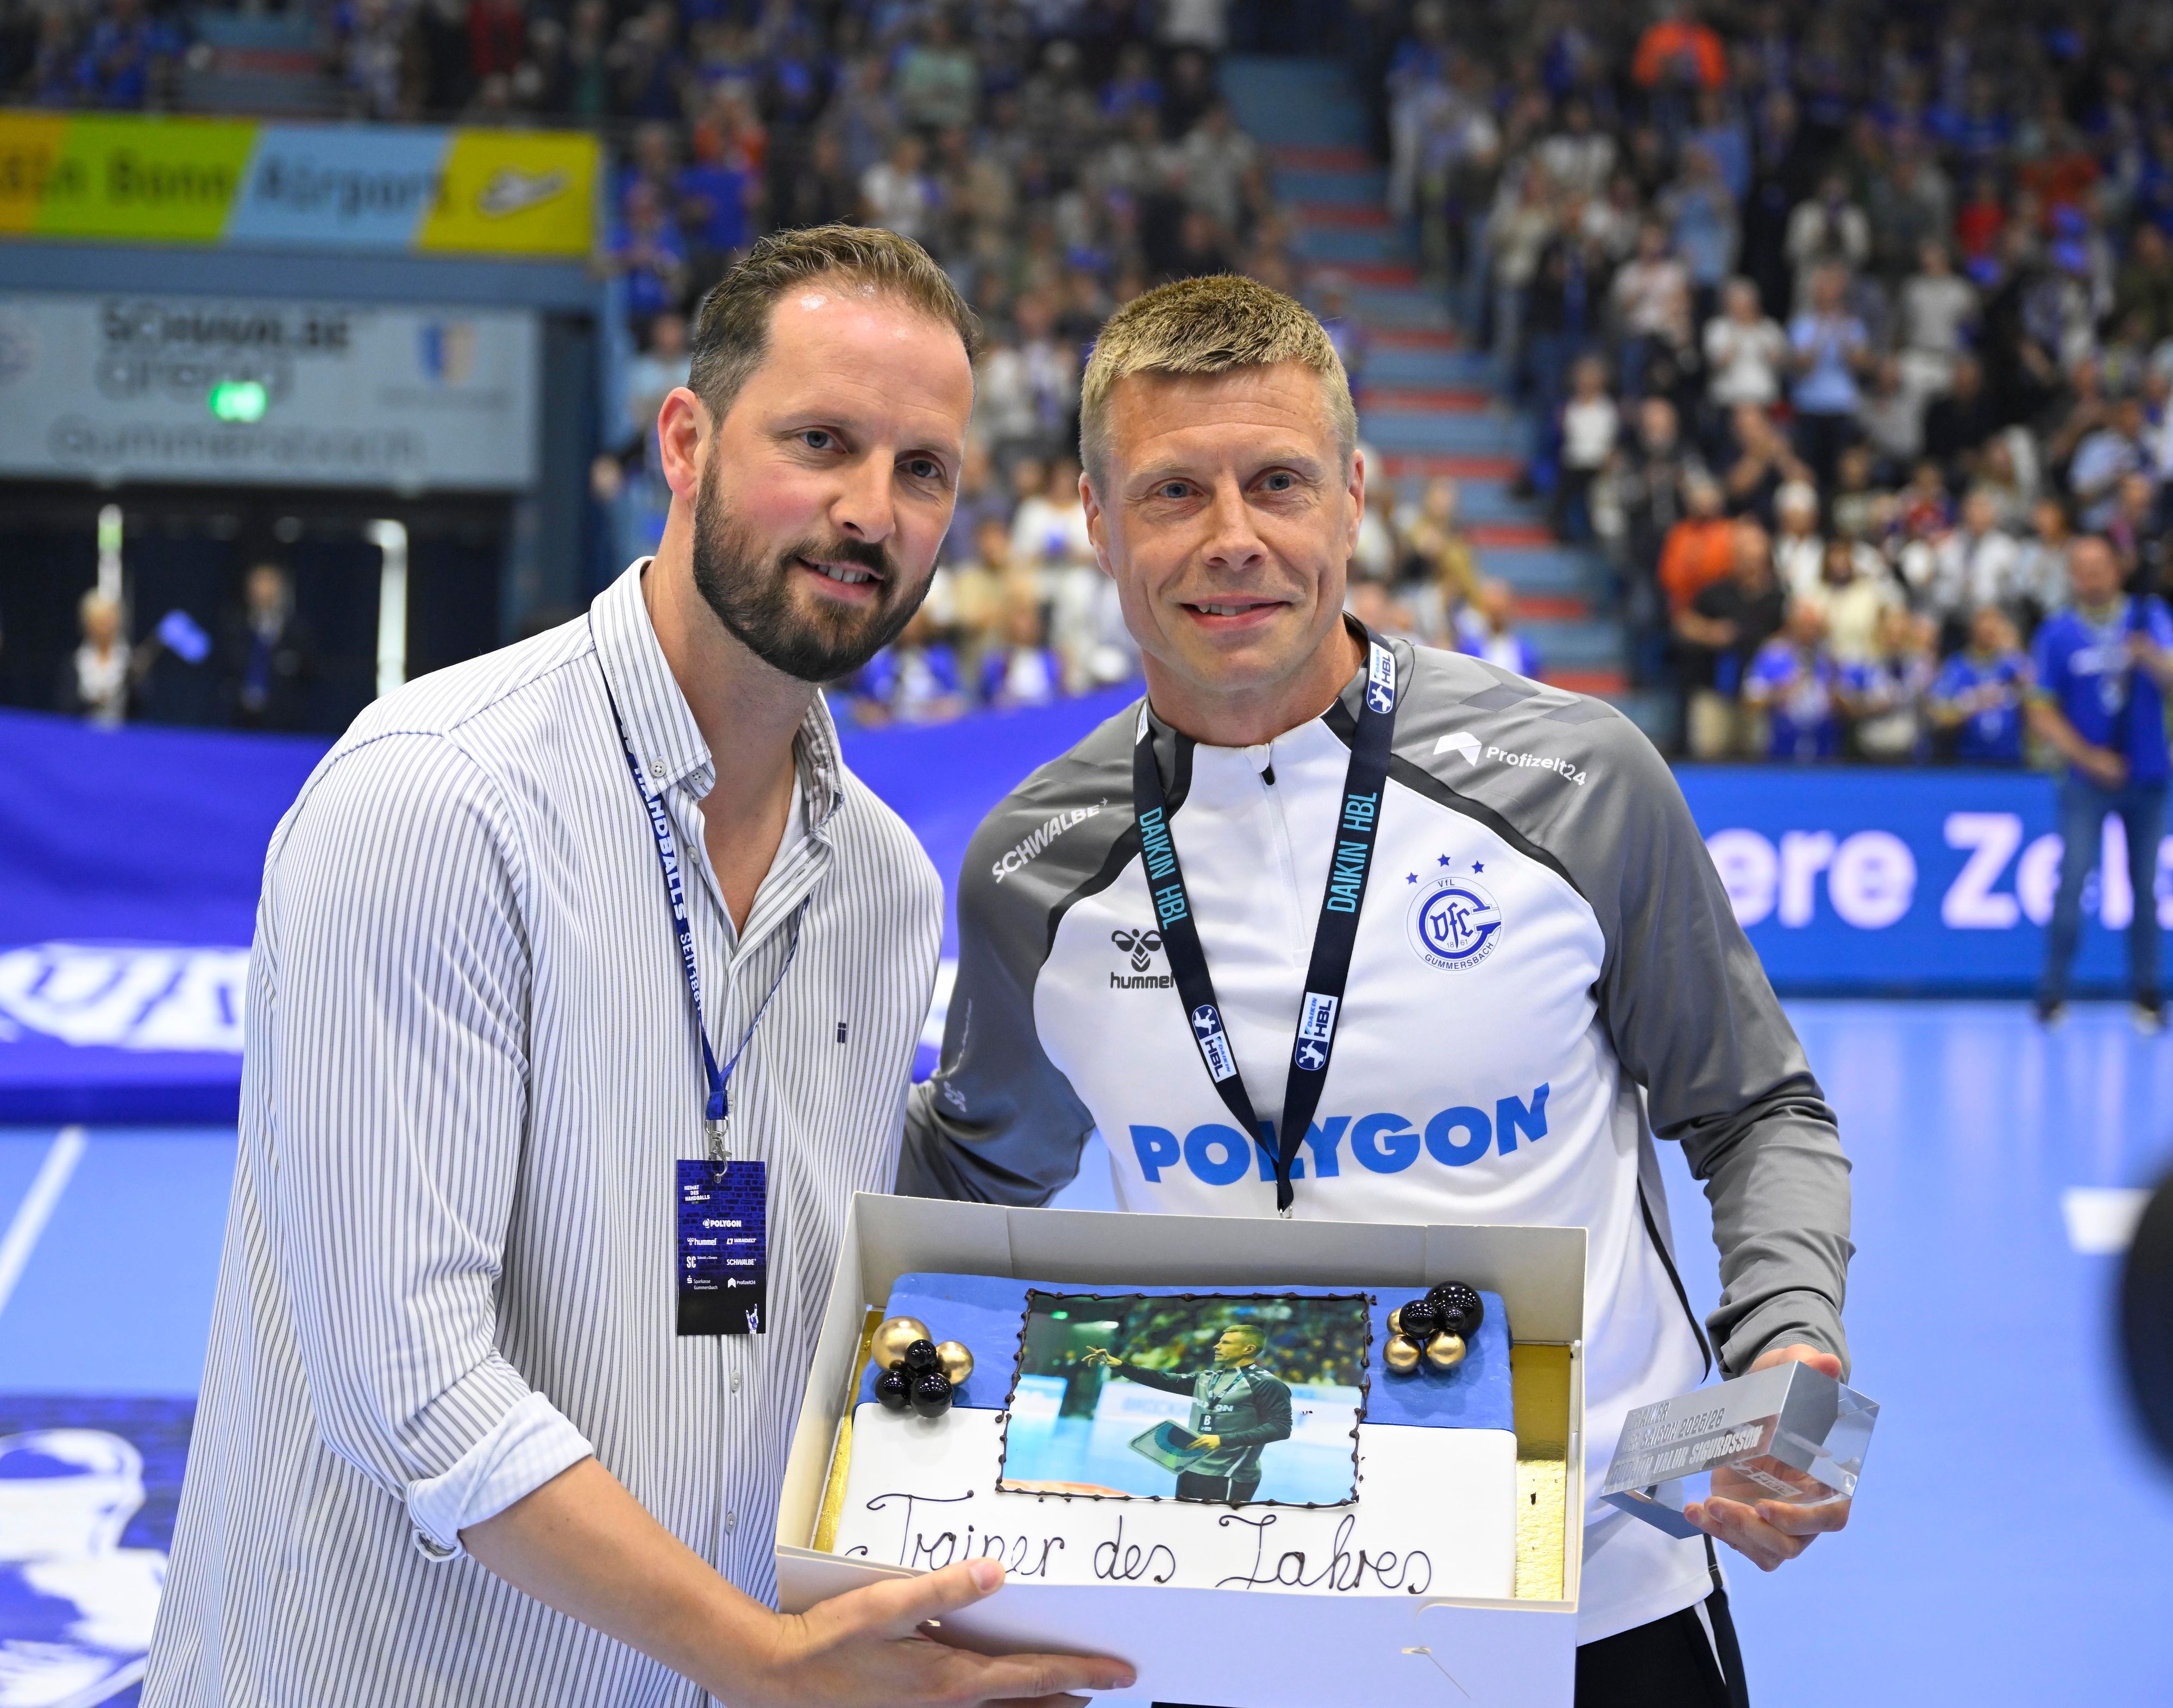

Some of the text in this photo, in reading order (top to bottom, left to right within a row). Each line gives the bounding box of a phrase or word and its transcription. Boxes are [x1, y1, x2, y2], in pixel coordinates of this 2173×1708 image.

[1381, 655, 1391, 684] HBL
[992, 806, 1100, 883] SCHWALBE
[1327, 792, 1377, 913] DAIKIN HBL
[1140, 807, 1188, 930] DAIKIN HBL
[1438, 879, 1455, 887] VfL
[680, 932, 695, 969] SEIT
[1425, 942, 1494, 970] GUMMERSBACH
[1110, 971, 1174, 989] hummel
[1307, 997, 1317, 1027] DAIKIN
[1314, 1000, 1332, 1037] HBL
[1205, 1039, 1223, 1077] HBL
[1219, 1044, 1230, 1072] DAIKIN
[1129, 1082, 1550, 1186] POLYGON
[1641, 1421, 1679, 1448] SAISON
[1678, 1408, 1725, 1438] 2025/26
[1653, 1446, 1690, 1474] VALUR
[847, 1490, 1065, 1577] Trainer
[1094, 1514, 1176, 1585] des
